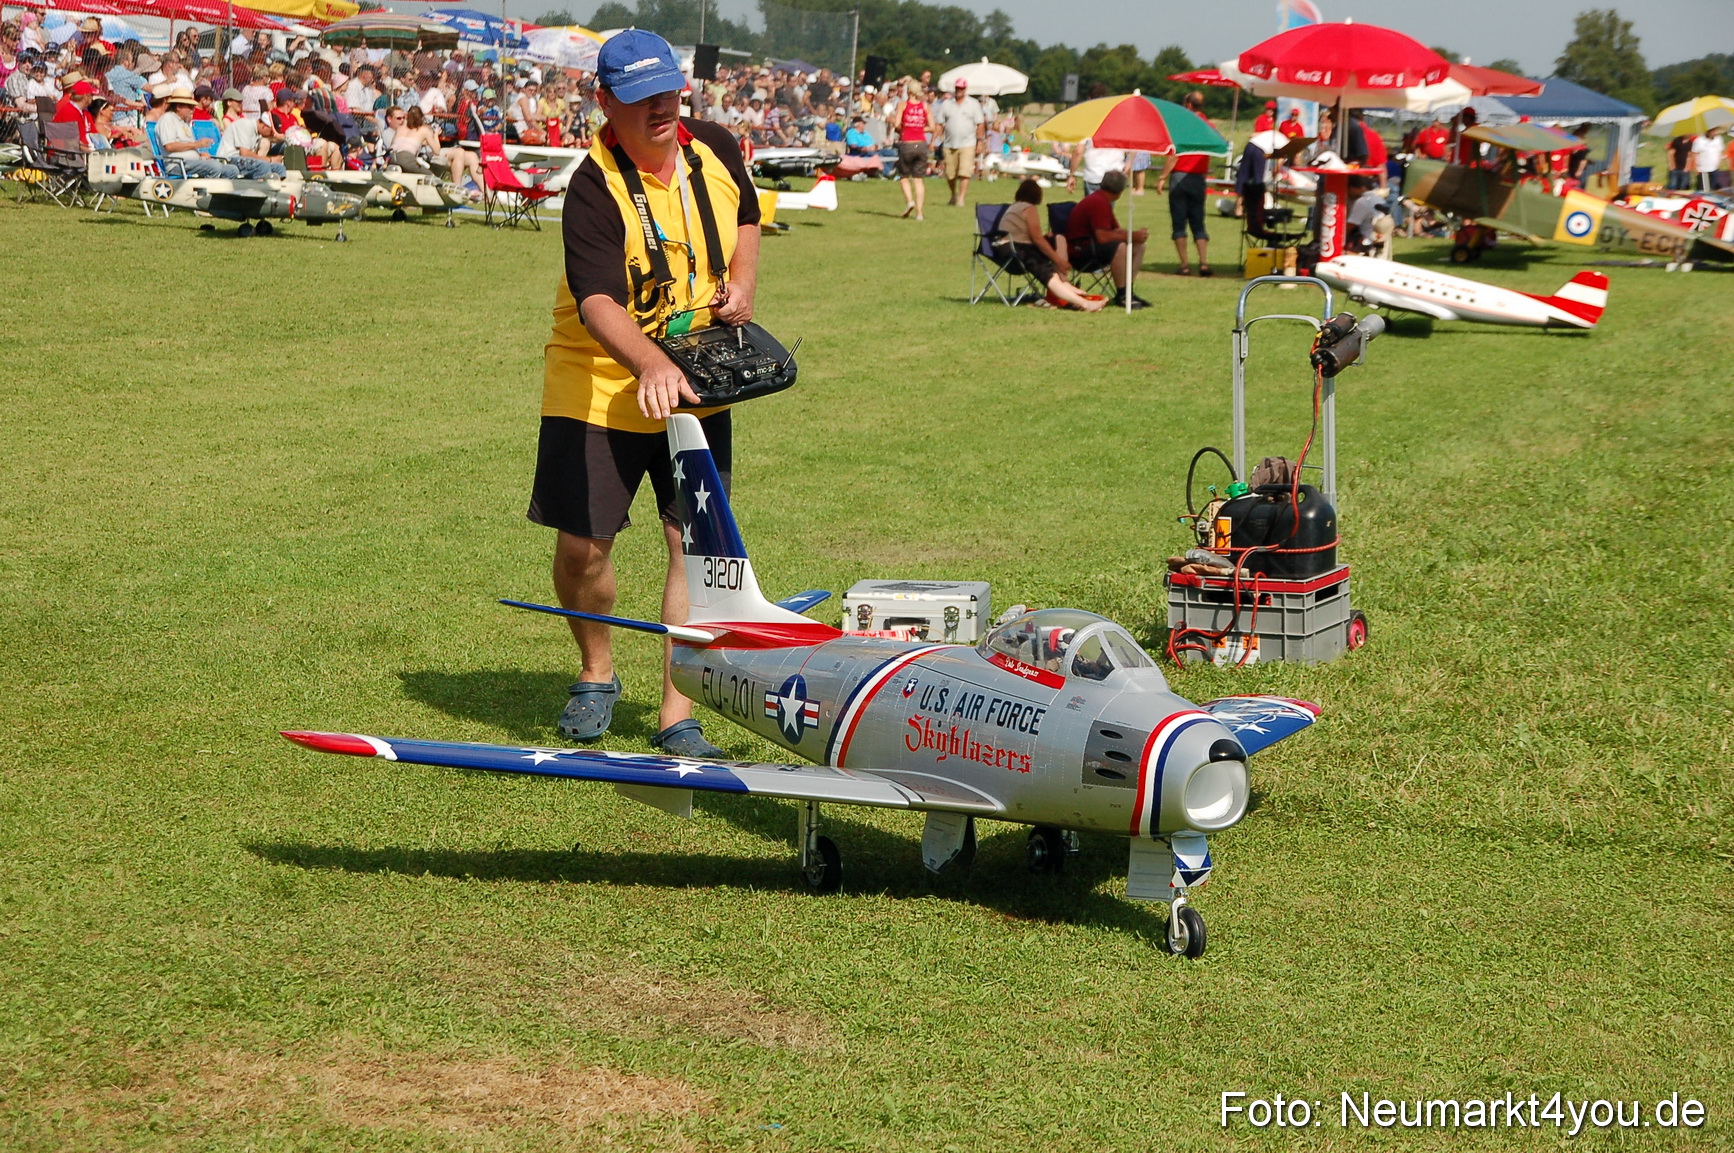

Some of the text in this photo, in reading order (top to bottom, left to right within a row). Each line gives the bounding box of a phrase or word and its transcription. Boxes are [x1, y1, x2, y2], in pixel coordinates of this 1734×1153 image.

[633, 193, 658, 251] Graupner
[703, 556, 745, 591] 31201
[702, 666, 756, 722] FU-201
[919, 684, 950, 715] U.S.
[954, 691, 986, 721] AIR
[985, 697, 1046, 736] FORCE
[905, 713, 1032, 774] Skyblazers
